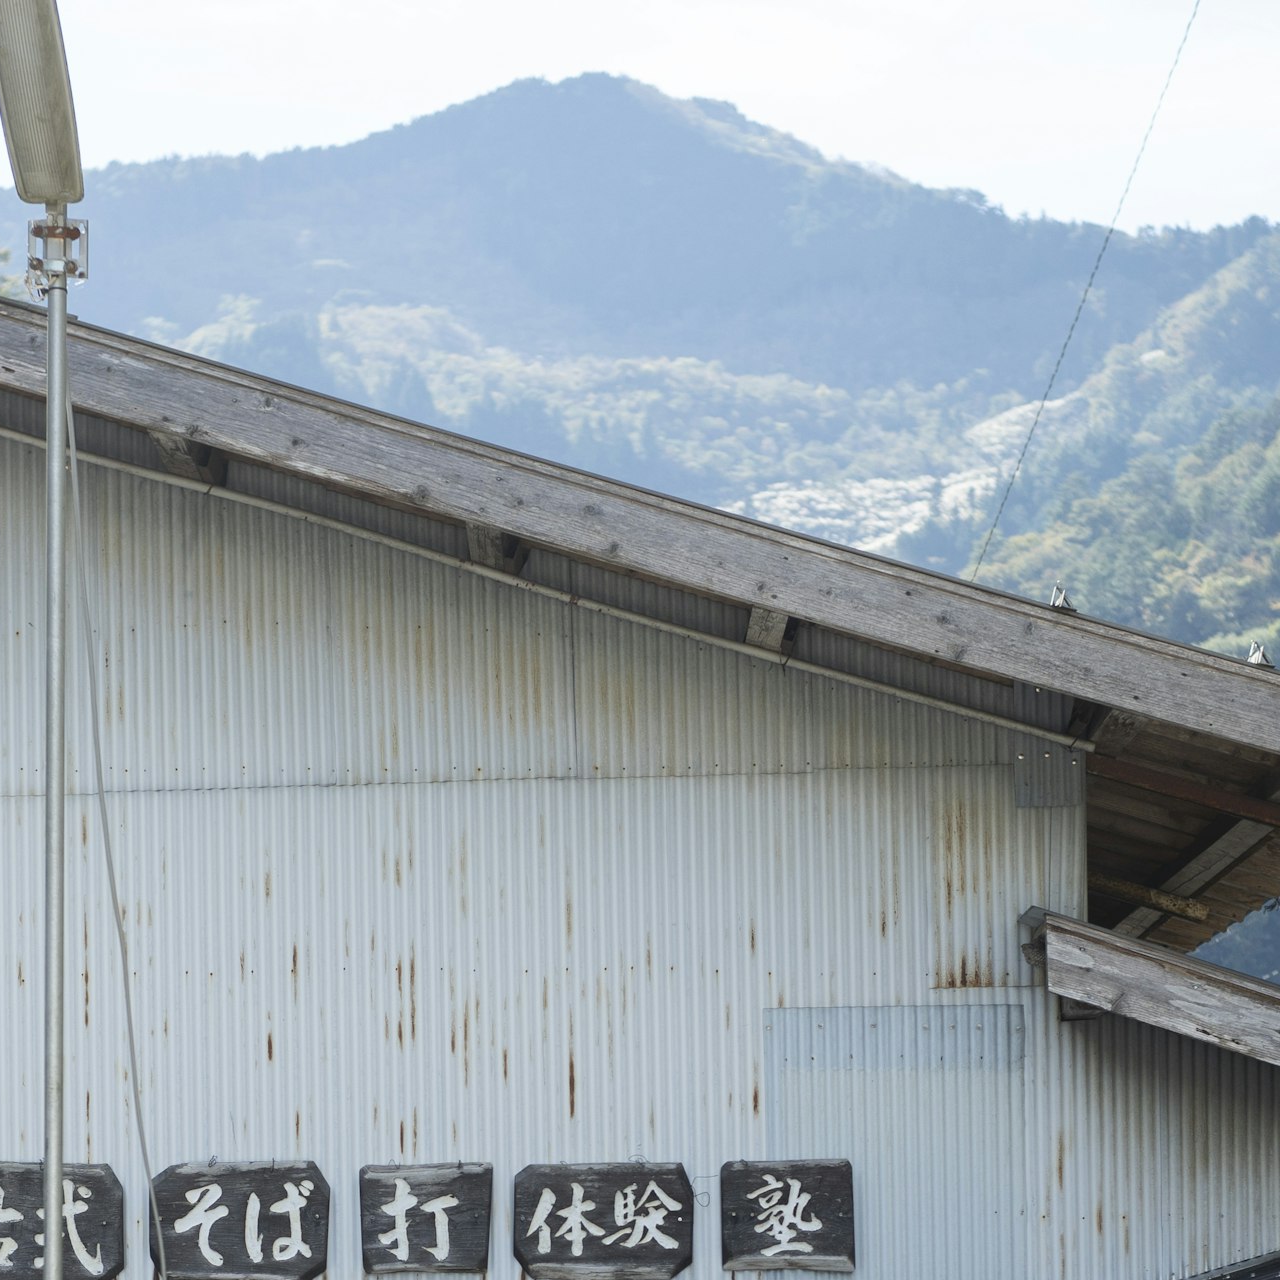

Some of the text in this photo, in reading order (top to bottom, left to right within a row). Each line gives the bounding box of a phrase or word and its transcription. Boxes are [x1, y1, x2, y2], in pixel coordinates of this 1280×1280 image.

[174, 1180, 315, 1266] そば
[377, 1179, 460, 1262] 打
[525, 1180, 682, 1257] 体験
[745, 1173, 823, 1258] 塾
